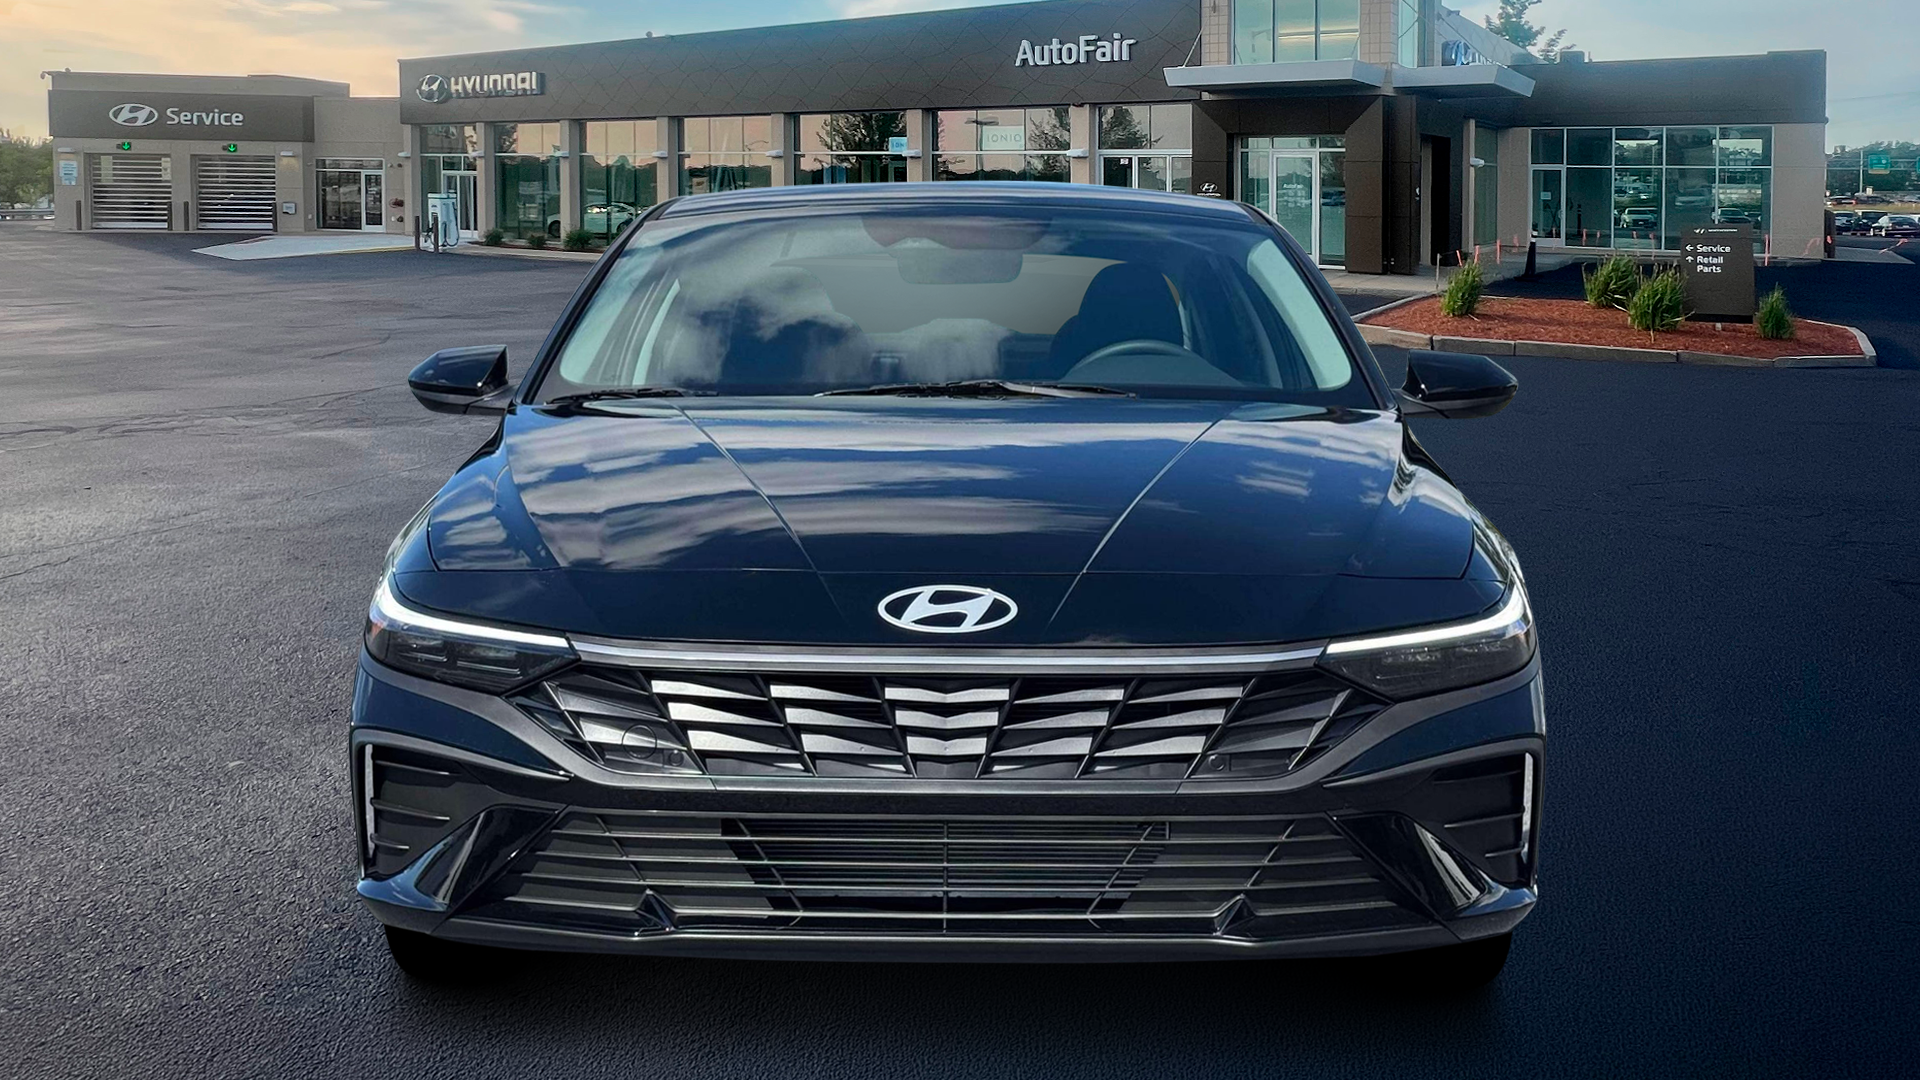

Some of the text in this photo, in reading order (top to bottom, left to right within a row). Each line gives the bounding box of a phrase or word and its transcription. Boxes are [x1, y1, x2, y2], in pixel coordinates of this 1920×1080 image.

[1015, 32, 1137, 67] AutoFair
[450, 71, 538, 97] HYUNDAI
[166, 108, 244, 126] Service
[1696, 244, 1731, 253] Service
[1696, 255, 1724, 264] Retail
[1696, 265, 1722, 273] Parts
